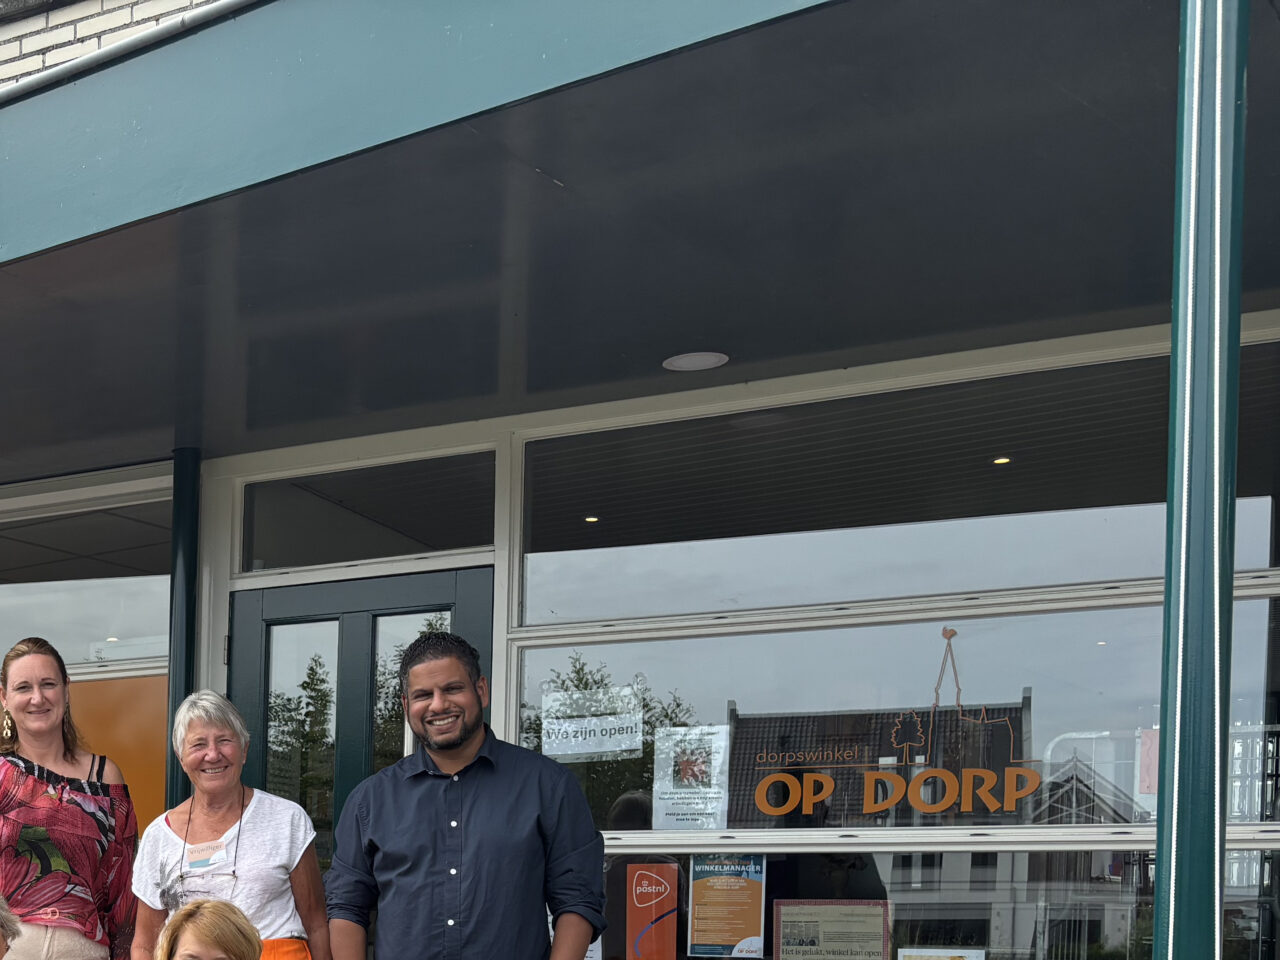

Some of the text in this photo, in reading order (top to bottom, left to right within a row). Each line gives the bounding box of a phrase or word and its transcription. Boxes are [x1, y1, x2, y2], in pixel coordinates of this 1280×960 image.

[546, 722, 638, 741] We zijn open!
[756, 744, 858, 766] dorpswinkel
[755, 767, 1041, 816] OP DORP
[695, 864, 761, 872] WINKELMANAGER
[637, 884, 665, 894] postnl
[802, 948, 825, 957] gelukt,
[826, 948, 849, 956] winkel
[850, 948, 863, 956] kan
[864, 949, 882, 957] open
